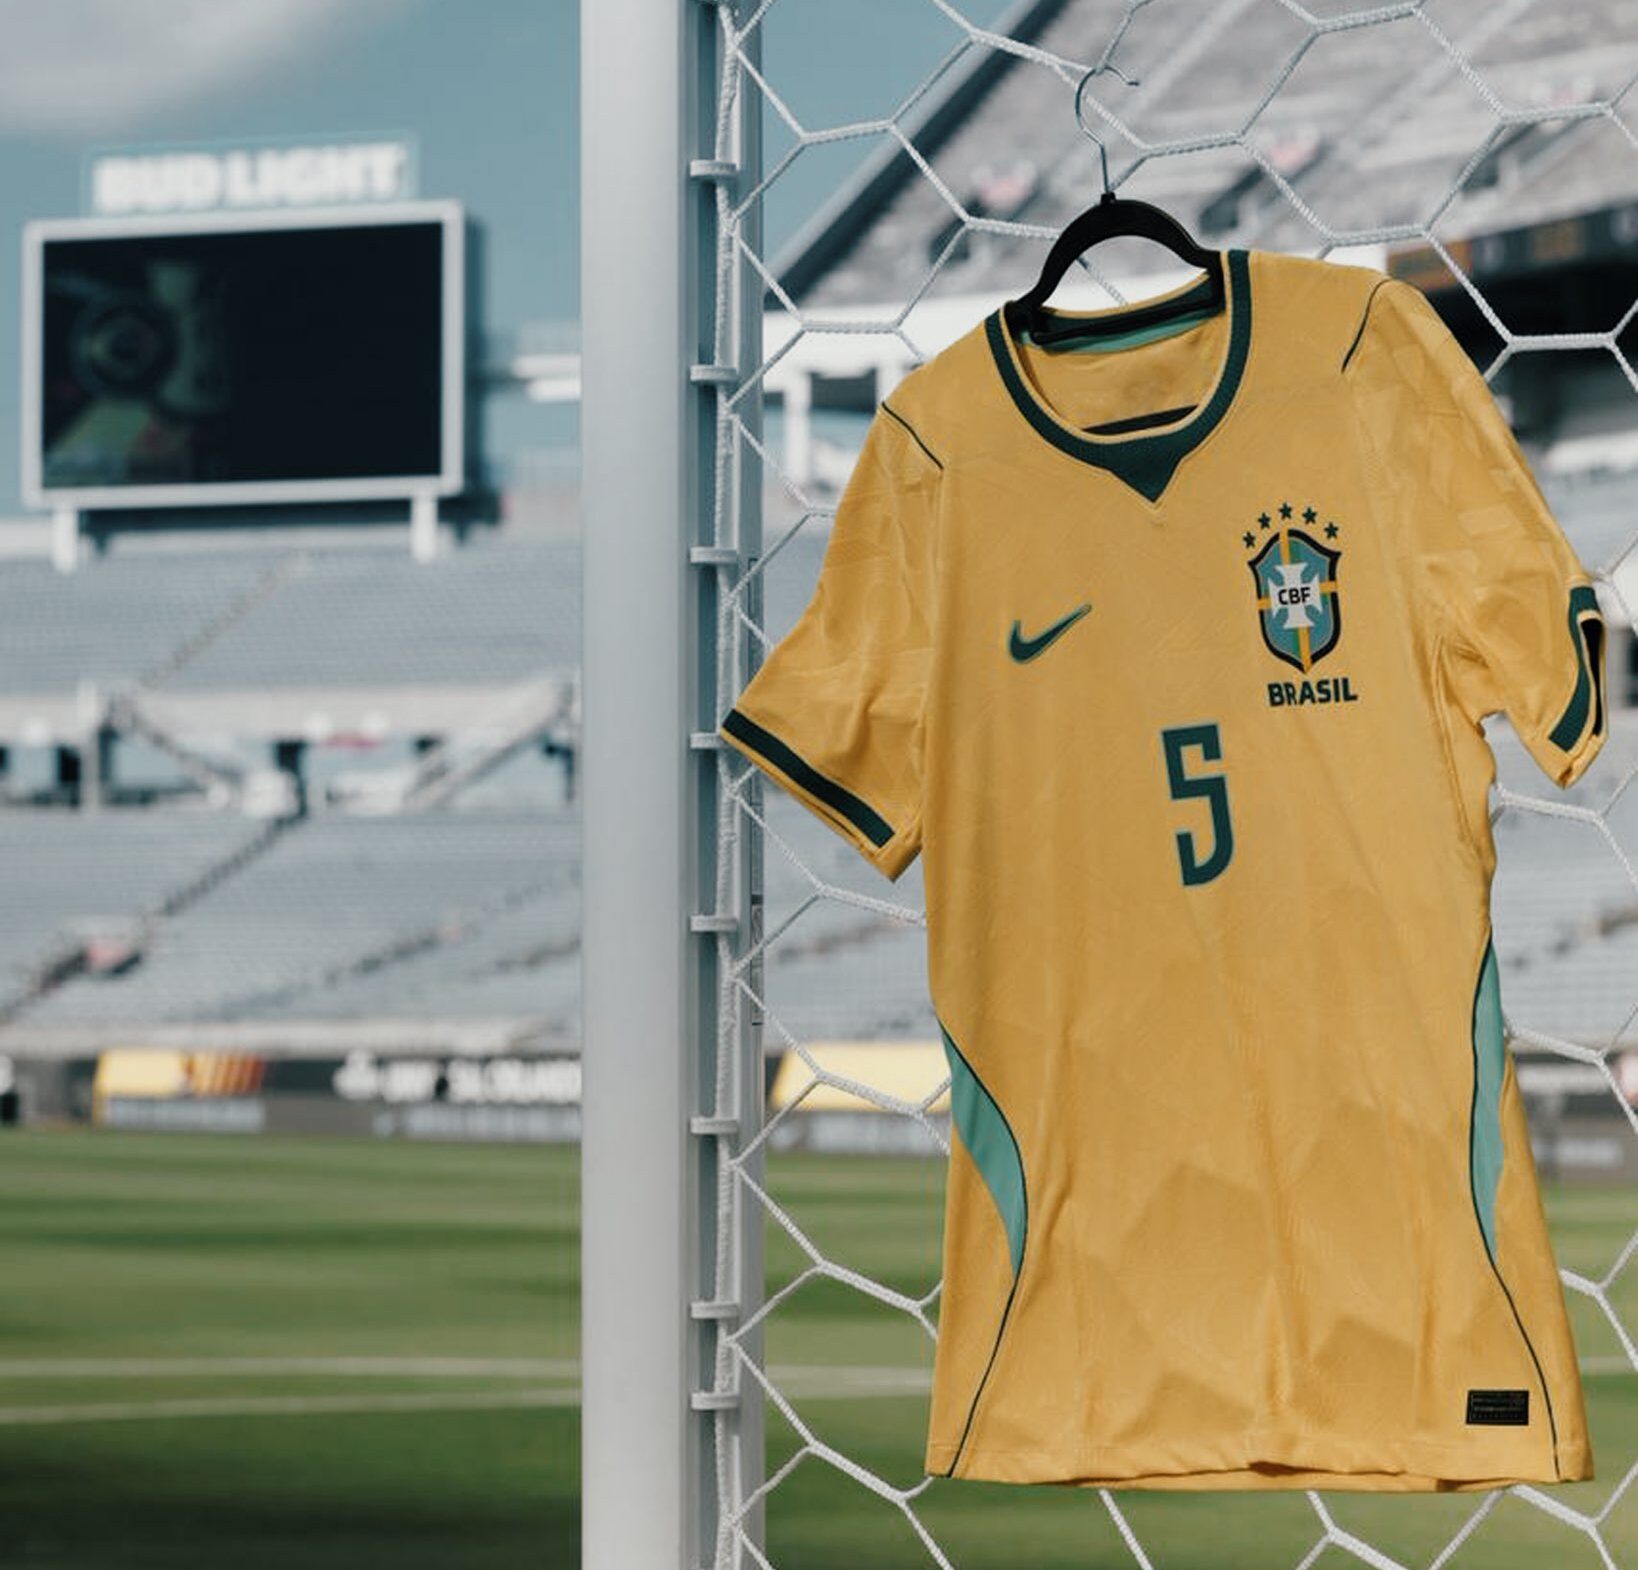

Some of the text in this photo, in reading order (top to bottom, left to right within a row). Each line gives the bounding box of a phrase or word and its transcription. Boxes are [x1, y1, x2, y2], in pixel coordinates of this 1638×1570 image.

[1278, 587, 1311, 606] CBF
[1268, 678, 1358, 707] BRASIL
[1162, 724, 1234, 886] 5
